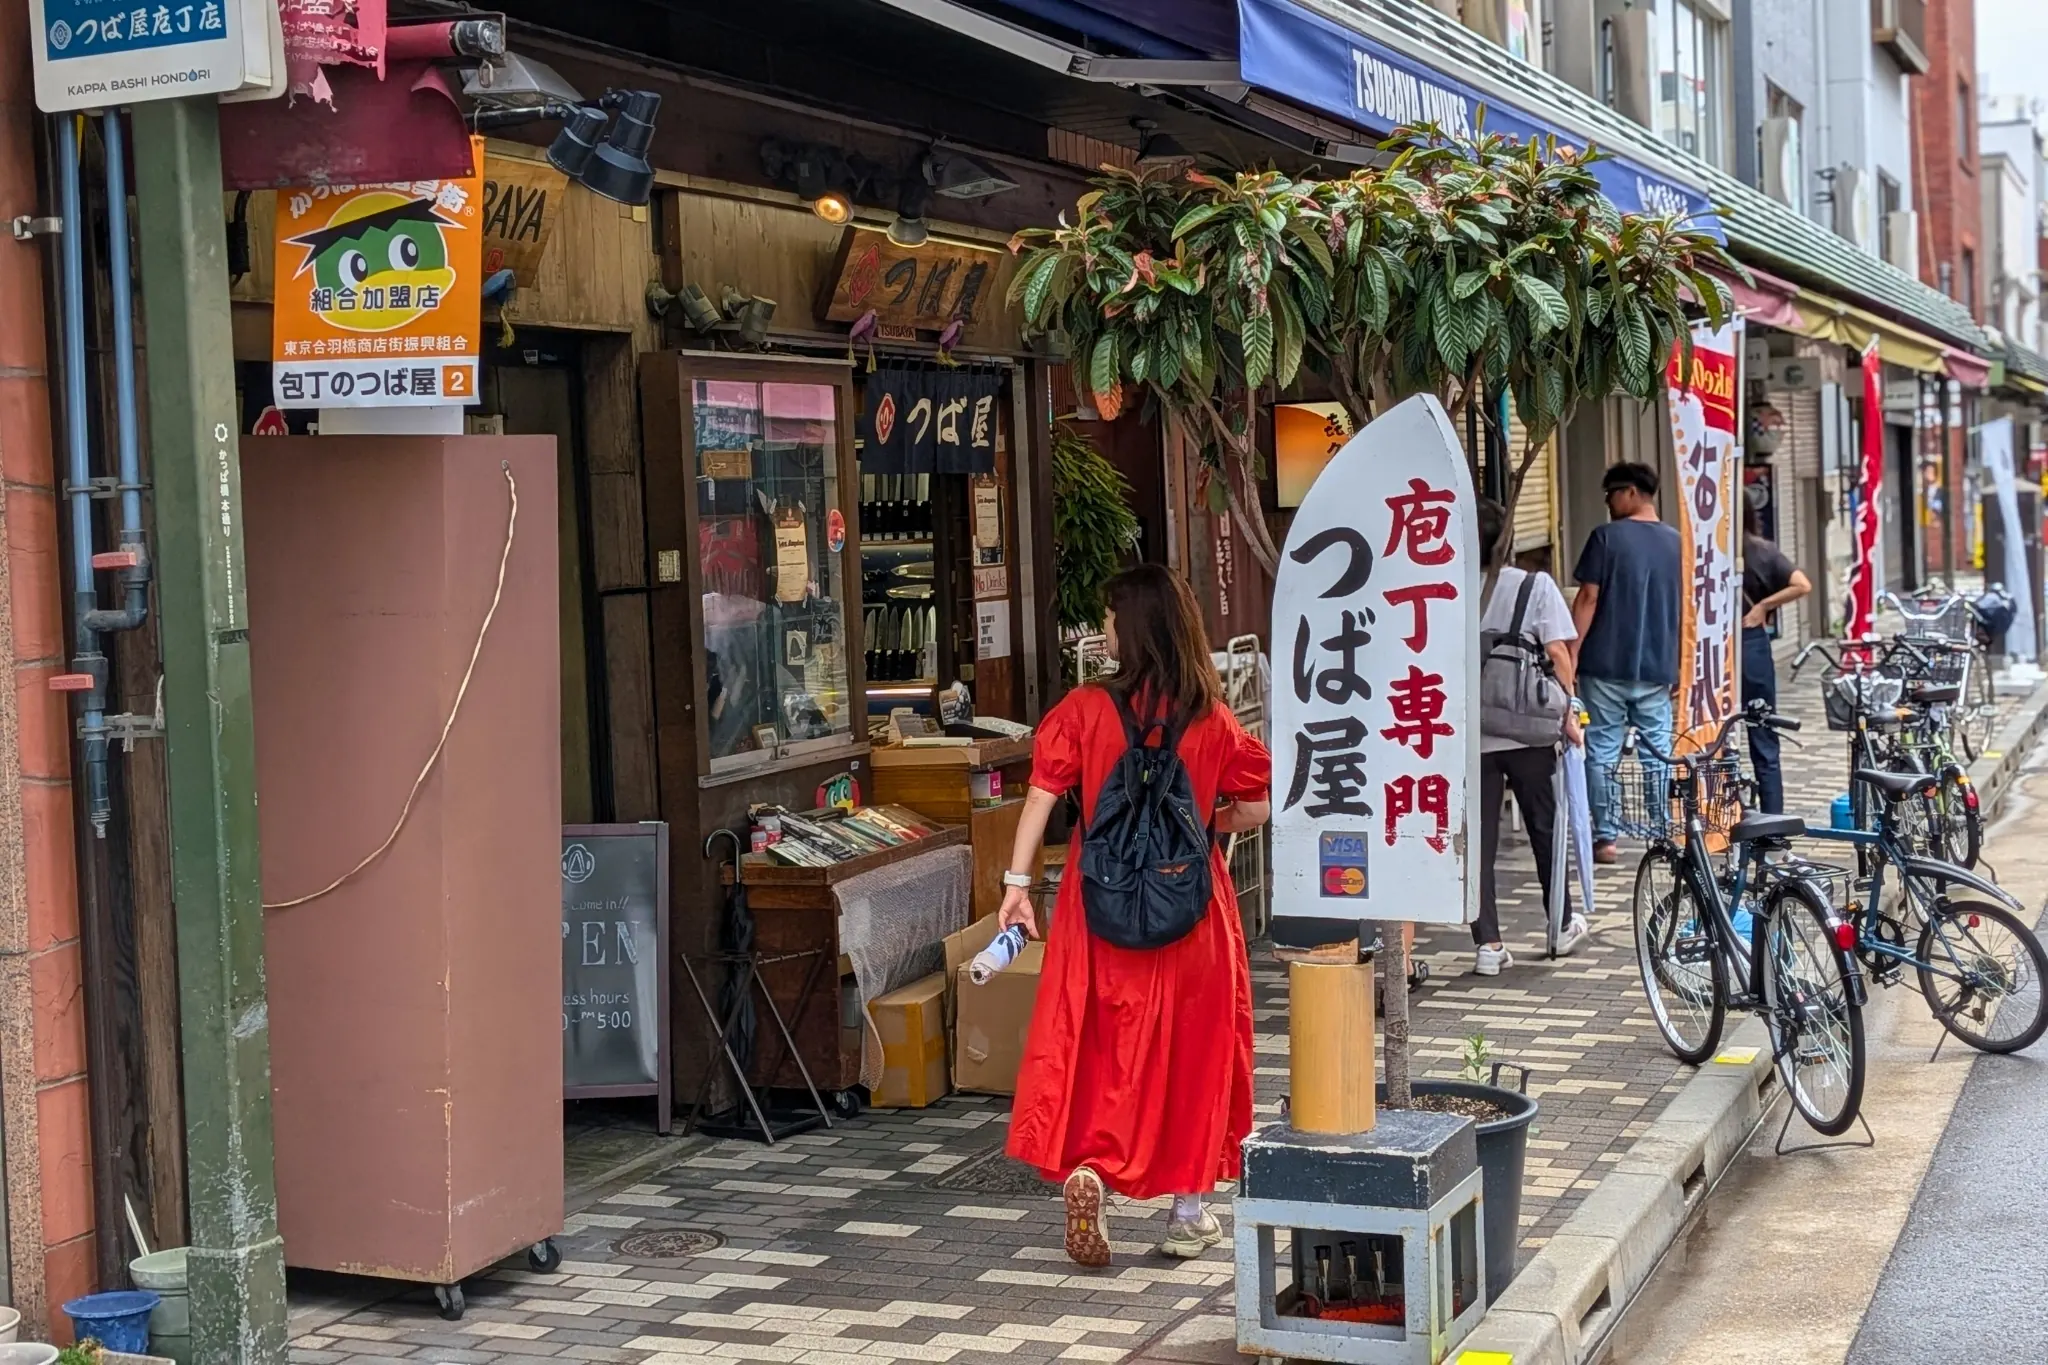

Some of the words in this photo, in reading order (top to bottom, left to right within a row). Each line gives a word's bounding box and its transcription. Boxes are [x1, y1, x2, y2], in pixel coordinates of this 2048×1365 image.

[68, 82, 107, 96] KAPPA
[111, 77, 147, 90] BASHI
[151, 69, 211, 85] HONDORI
[1352, 48, 1421, 126] TSUBAYA
[1420, 80, 1471, 141] KNIVES
[310, 284, 440, 312] 組合加盟店
[885, 256, 989, 324] つば屋
[880, 324, 915, 338] TSUBAYA
[284, 335, 468, 356] 東京合羽橋商店街振興組合
[279, 367, 437, 400] 包丁のつば屋
[450, 372, 465, 391] 2
[906, 395, 993, 448] つば屋
[976, 574, 985, 593] No
[986, 570, 1006, 591] Drinks
[1281, 525, 1376, 819] つば屋
[1379, 477, 1459, 854] 庖丁専門
[1324, 837, 1365, 853] VISA
[590, 987, 630, 1005] hours
[597, 1010, 631, 1029] 5:00
